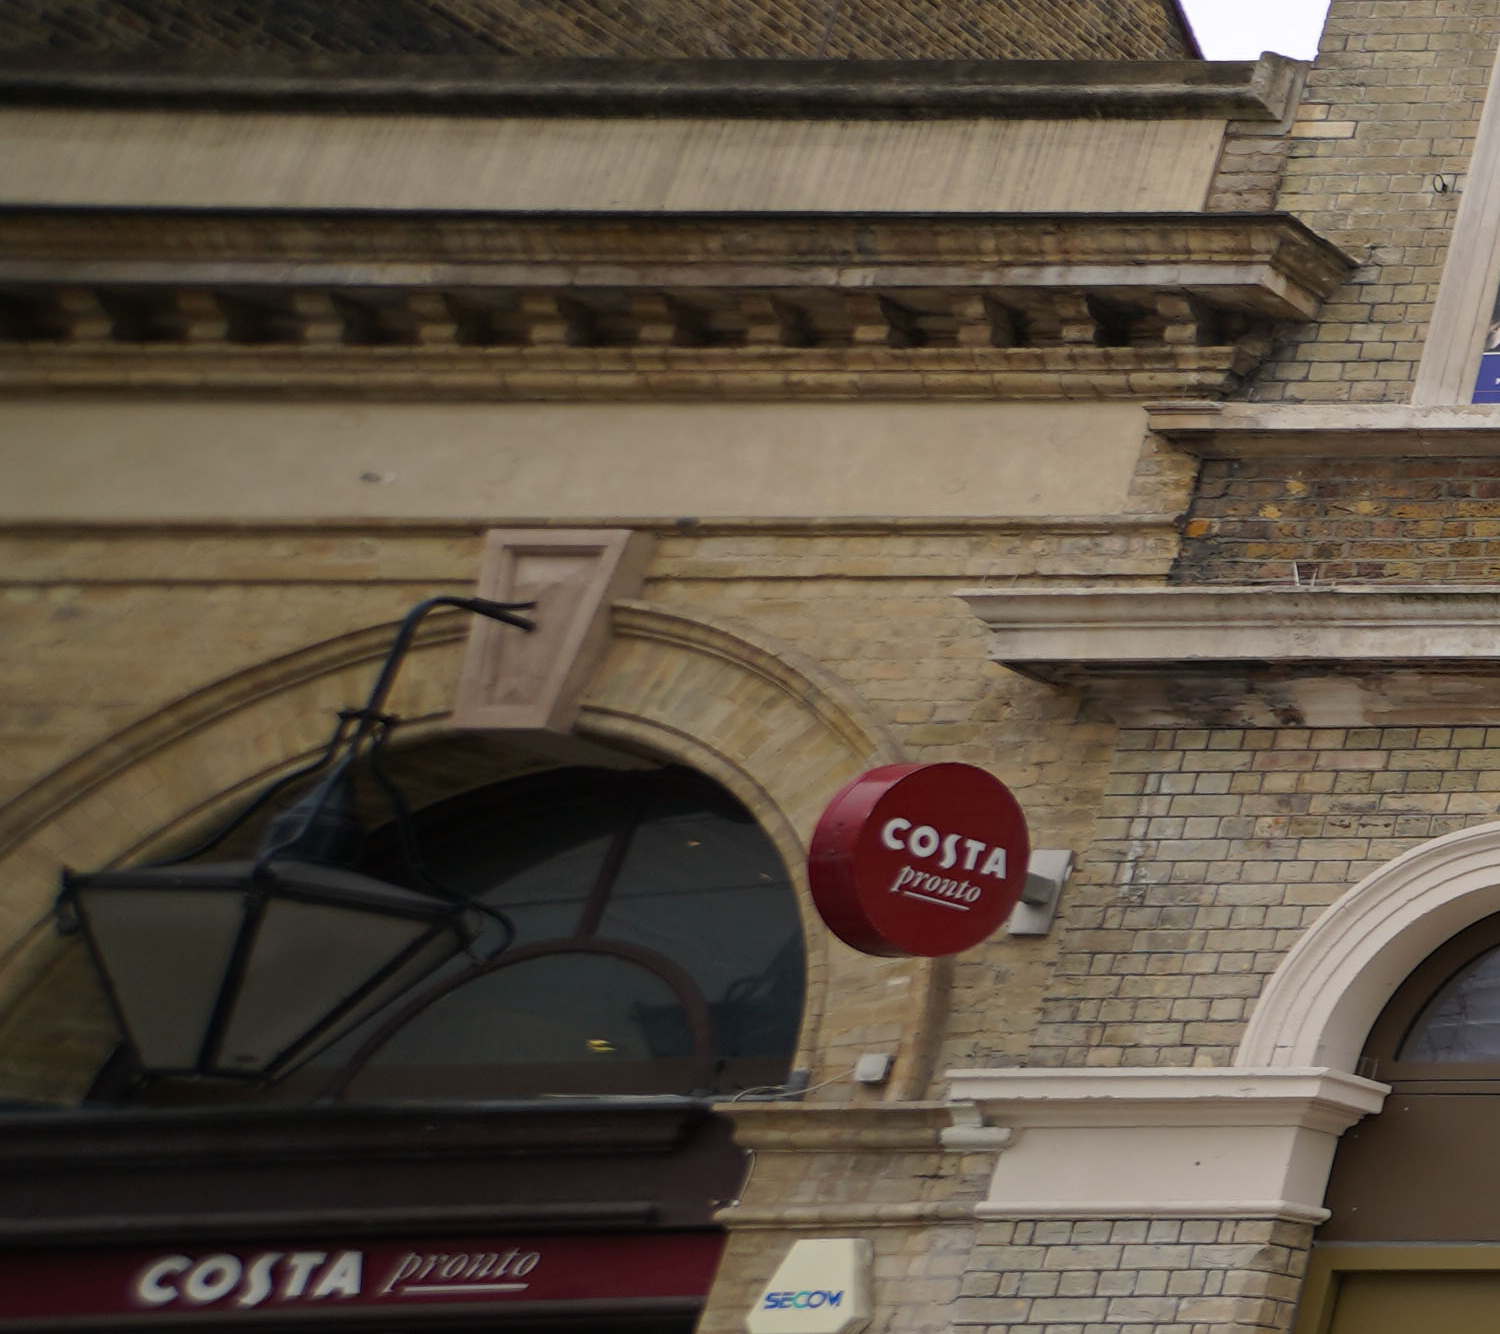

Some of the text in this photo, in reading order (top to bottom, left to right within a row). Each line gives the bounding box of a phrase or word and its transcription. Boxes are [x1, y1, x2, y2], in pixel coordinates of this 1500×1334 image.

[882, 817, 1007, 880] COSTA
[889, 865, 982, 903] pronto
[138, 1247, 540, 1308] COSTA pronto
[764, 1290, 844, 1309] SECOM
